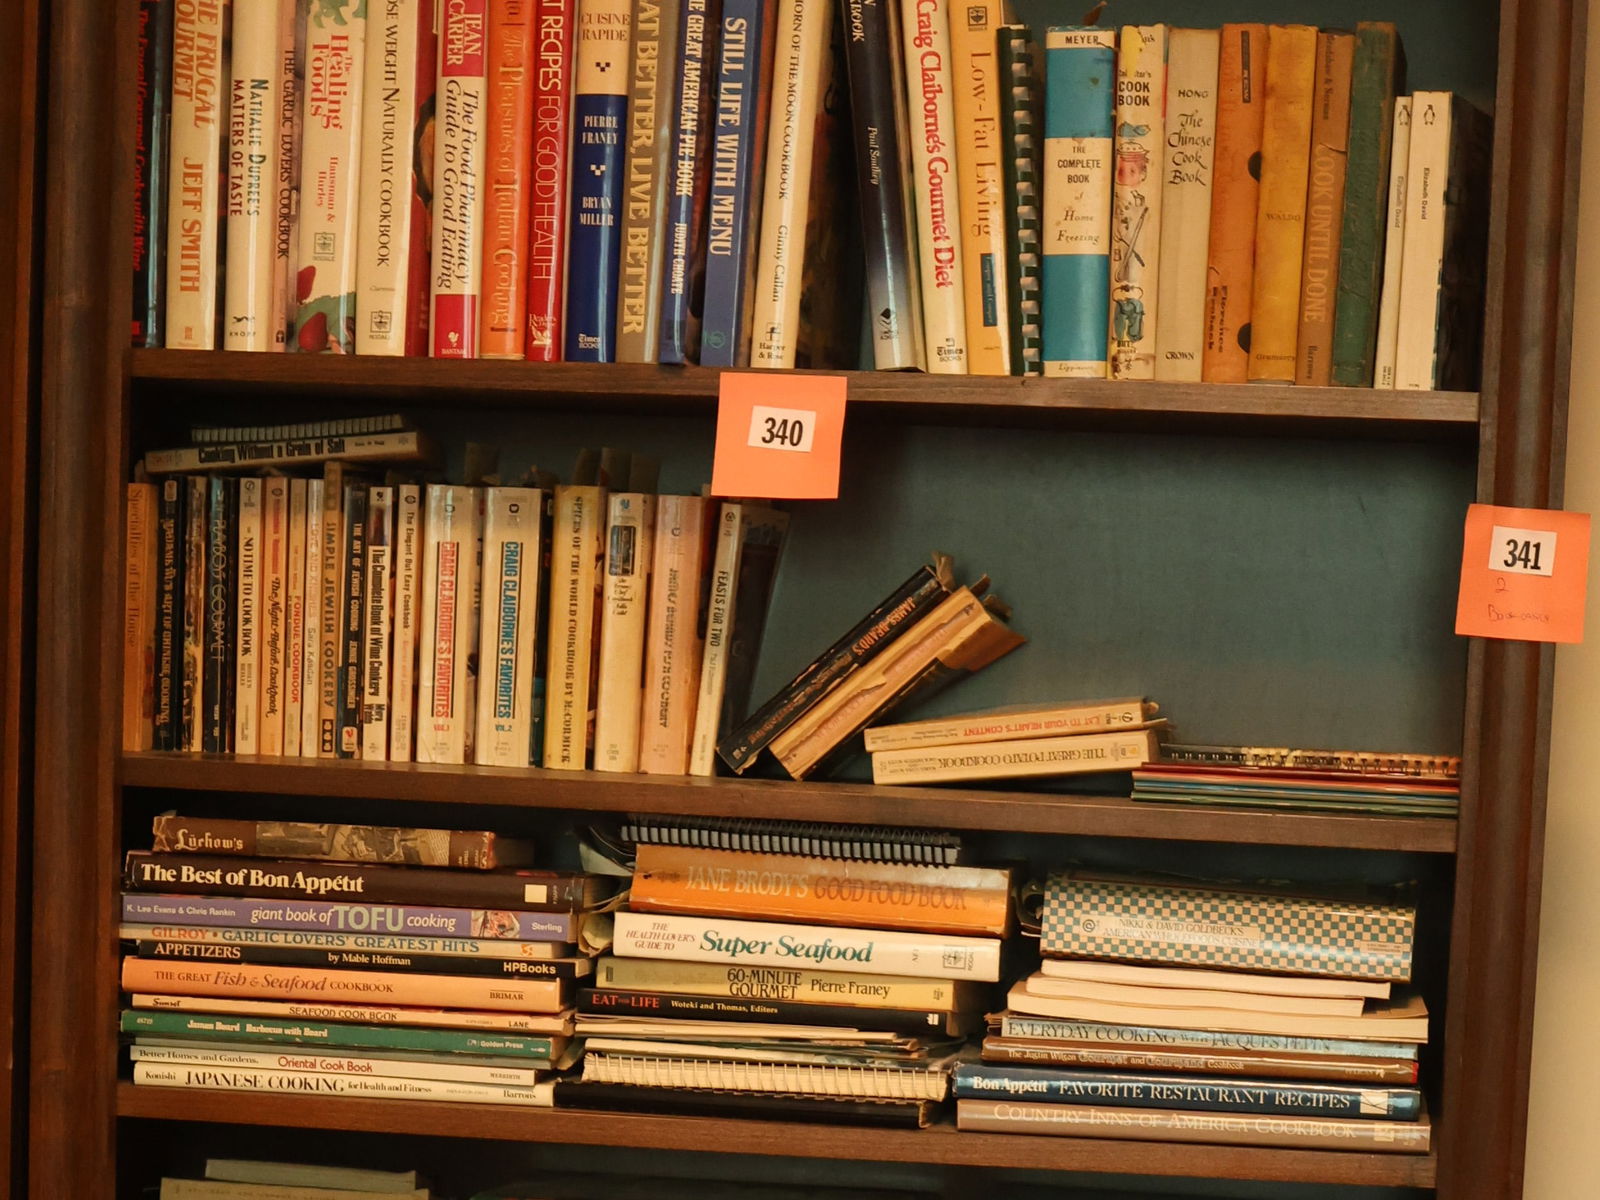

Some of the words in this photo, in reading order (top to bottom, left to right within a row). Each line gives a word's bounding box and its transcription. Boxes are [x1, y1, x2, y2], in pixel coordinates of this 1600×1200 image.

[581, 13, 629, 26] CUISINE
[914, 0, 932, 48] Craig
[582, 29, 627, 42] RAPIDE
[723, 17, 747, 75] STILL
[1065, 35, 1098, 44] MEYER
[1119, 81, 1150, 92] COOK
[1178, 89, 1208, 98] HONG
[446, 80, 461, 135] Guide
[462, 91, 479, 121] The
[718, 82, 742, 127] LIFE
[917, 52, 939, 153] Claiborne's
[1118, 95, 1150, 106] BOOK
[232, 80, 243, 148] MATTERS
[584, 116, 618, 129] PIERRE
[1179, 113, 1203, 128] The
[461, 126, 475, 167] Food
[582, 133, 618, 144] FRANEY
[1168, 132, 1211, 148] Chinese
[232, 152, 242, 169] OF
[444, 143, 458, 159] to
[715, 134, 739, 188] WITH
[1172, 152, 1205, 170] Cook
[1058, 159, 1101, 169] COMPLETE
[182, 158, 202, 212] JEFF
[1068, 174, 1089, 183] BOOK
[1168, 169, 1206, 185] Book
[231, 174, 242, 216] TASTE
[442, 164, 458, 219] Good
[582, 197, 612, 209] BRYAN
[927, 157, 949, 242] Gourmet
[455, 171, 475, 284] Pharmacy
[579, 213, 614, 226] MILLER
[710, 195, 733, 256] MENU
[1064, 209, 1093, 222] Home
[1057, 230, 1099, 244] Freezing
[180, 222, 200, 292] SMITH
[437, 224, 457, 288] Eating
[935, 247, 953, 288] Diet
[762, 418, 803, 446] 340
[200, 448, 235, 463] Cooking
[239, 444, 273, 460] Without
[277, 445, 283, 458] a
[286, 442, 312, 458] Grain
[314, 442, 324, 456] of
[327, 440, 346, 454] Salt
[325, 522, 334, 570] SIMPLE
[1504, 539, 1541, 570] 341
[716, 571, 728, 605] FEASTS
[325, 578, 334, 633] JEWISH
[713, 608, 724, 627] FOR
[710, 630, 721, 646] TWO
[324, 640, 334, 707] COOKERY
[141, 864, 176, 881] The
[181, 866, 220, 884] Best
[226, 870, 247, 886] of
[250, 870, 289, 888] Bon
[252, 908, 283, 923] giant
[286, 909, 316, 921] book
[319, 909, 335, 922] of
[335, 904, 404, 931] TOFU
[407, 914, 456, 931] cooking
[154, 942, 241, 958] APPETIZERS
[328, 953, 339, 962] by
[342, 954, 369, 964] Mable
[372, 954, 411, 966] Hoffman
[503, 962, 556, 974] HPBooks
[700, 930, 771, 956] Super
[776, 936, 873, 962] Seafood
[727, 968, 802, 985] 60-MINUTE
[811, 978, 846, 994] Pierre
[849, 982, 890, 999] Franey
[729, 983, 799, 999] GOURMET
[278, 1056, 316, 1069] Oriental
[320, 1059, 344, 1070] Cook
[348, 1060, 372, 1072] Book
[186, 1071, 264, 1089] JAPANESE
[268, 1077, 344, 1092] COOKING
[1059, 1081, 1143, 1099] FAVORITE
[1150, 1085, 1267, 1104] RESTAURANT
[1275, 1091, 1349, 1109] RECIPES
